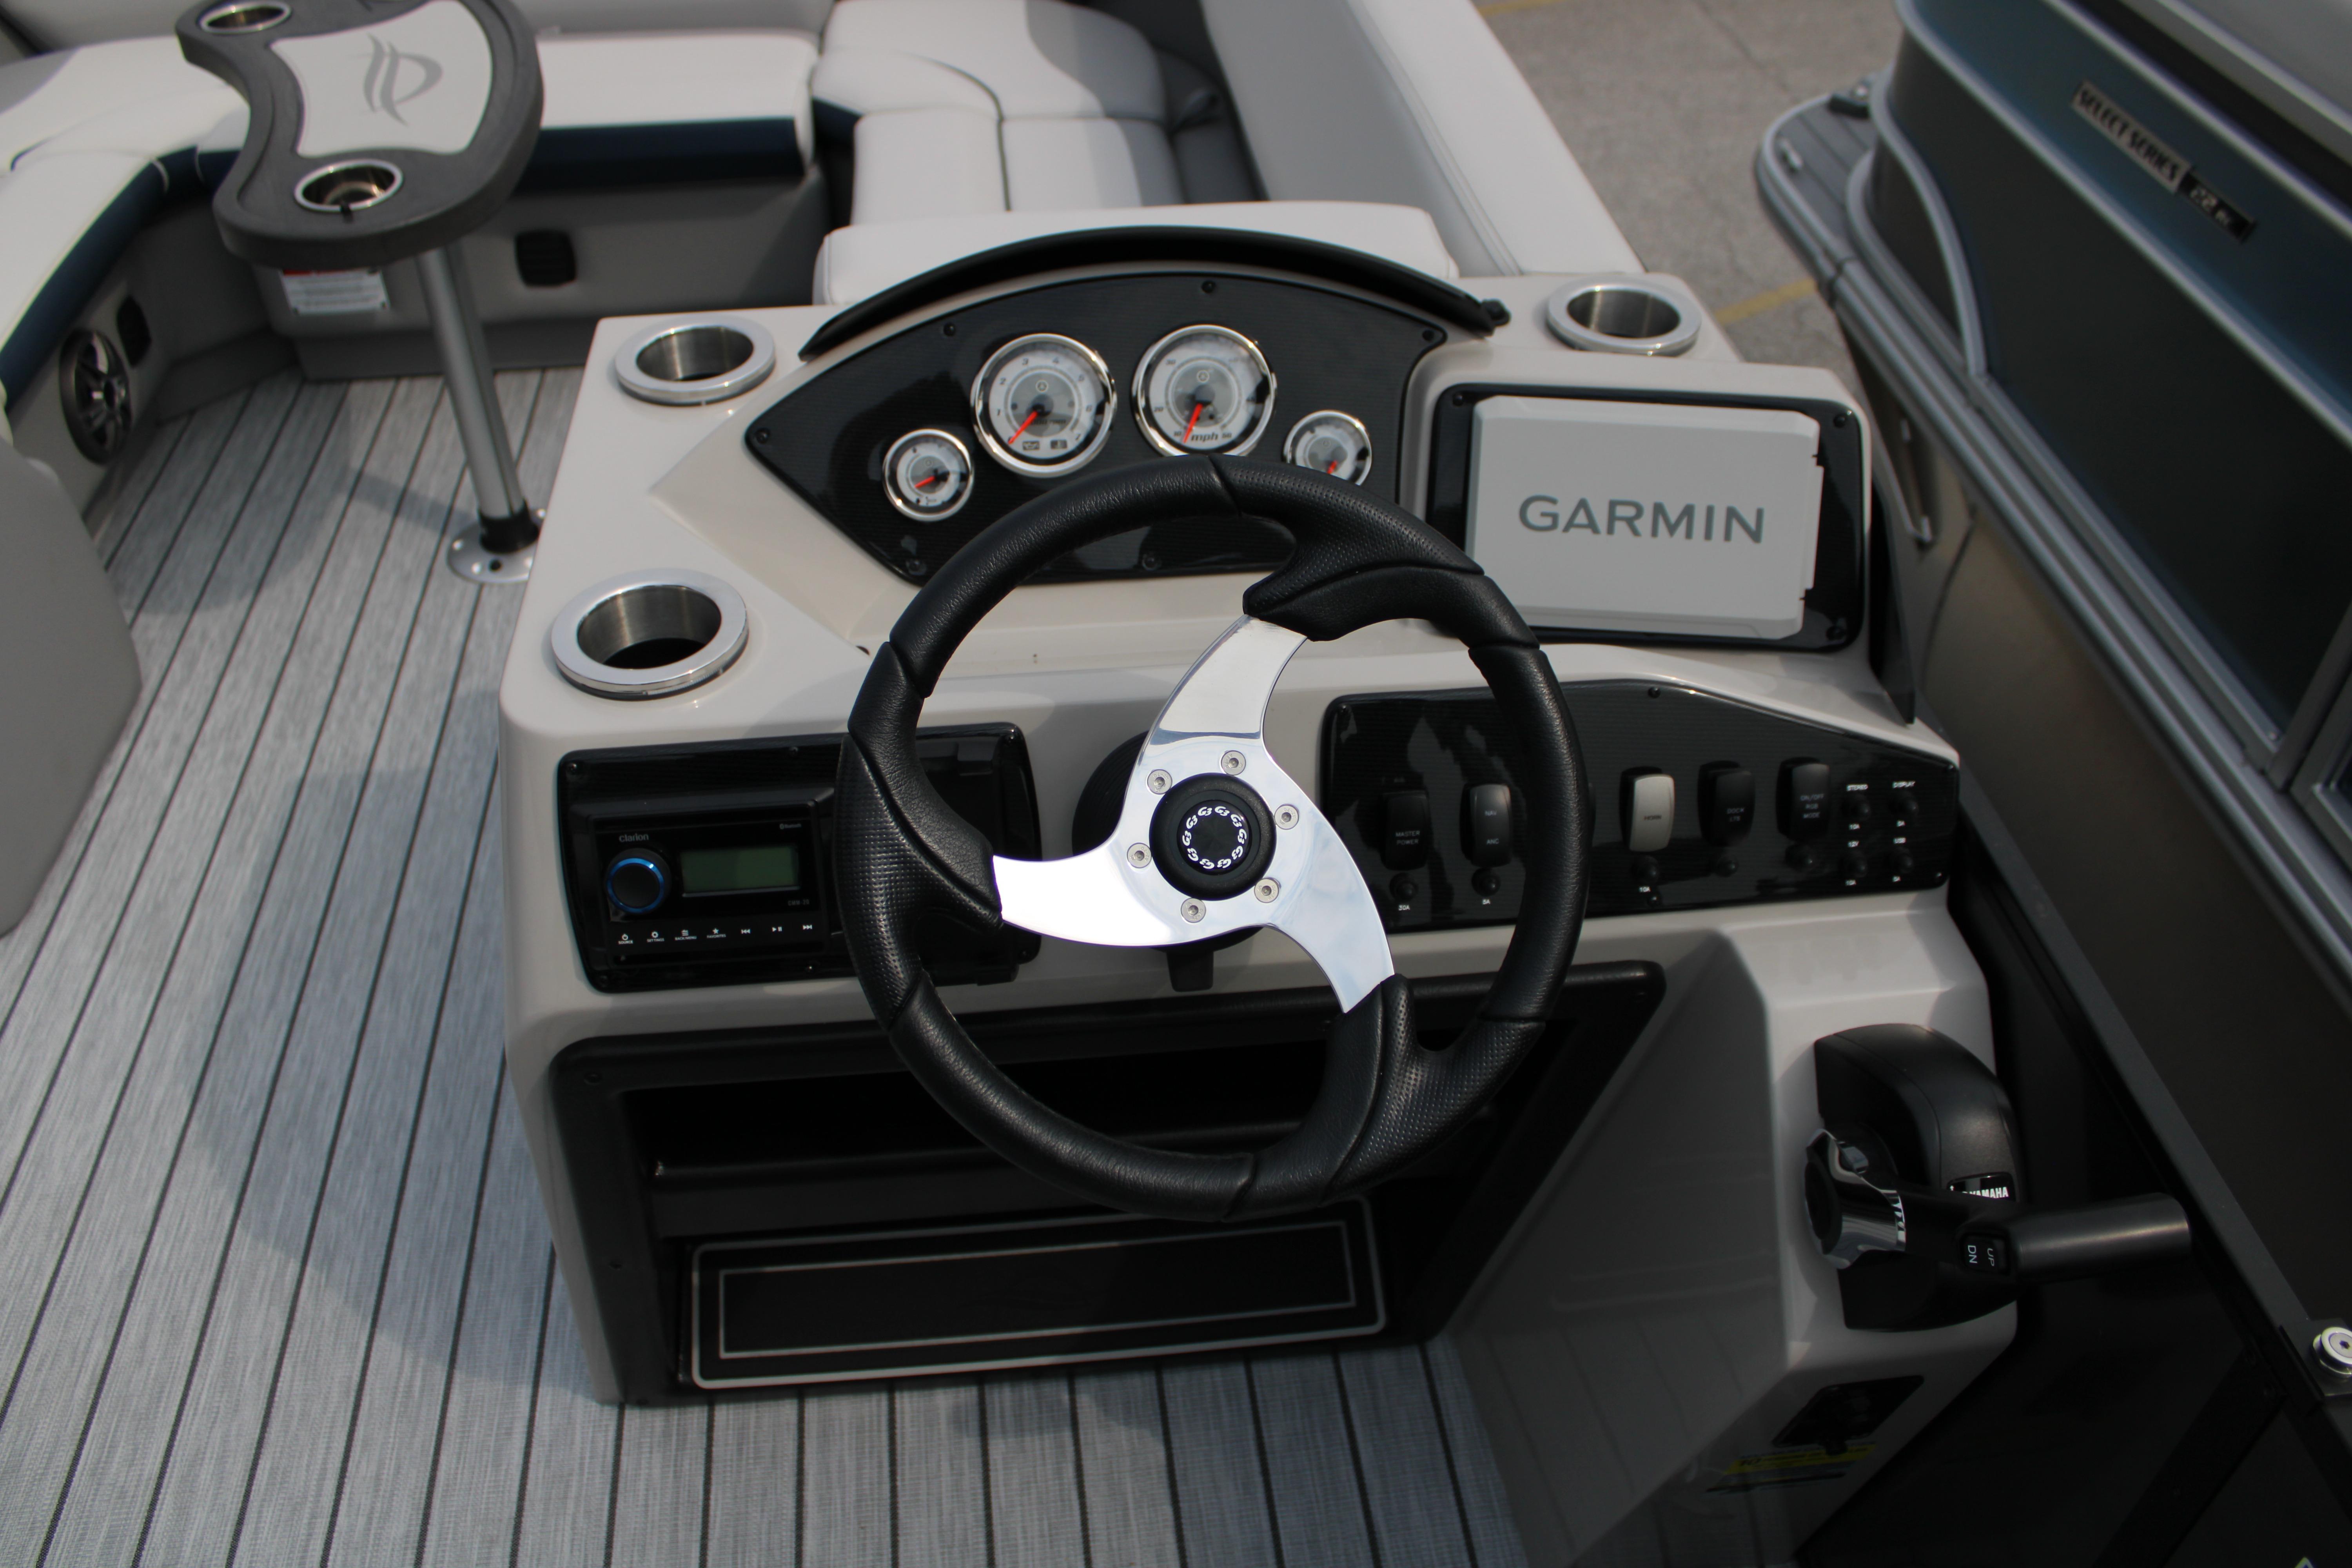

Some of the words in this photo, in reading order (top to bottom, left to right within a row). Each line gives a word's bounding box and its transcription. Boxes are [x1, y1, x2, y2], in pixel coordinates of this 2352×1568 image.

[2080, 90, 2129, 138] SELECT
[2130, 131, 2179, 182] SERIES
[1191, 432, 1218, 442] mph
[1519, 495, 1765, 544] GARMIN
[1198, 807, 1212, 816] G3
[1214, 806, 1230, 816] G3
[1186, 815, 1198, 829] G3
[1230, 814, 1242, 827] G3
[1182, 830, 1192, 846] G3
[1238, 829, 1247, 844] G3
[1187, 848, 1199, 861] G3
[1232, 846, 1243, 860] G3
[1199, 858, 1215, 869] G3
[1217, 858, 1231, 868] G3
[1967, 1245, 1978, 1263] DN
[1987, 1248, 1994, 1267] UP
